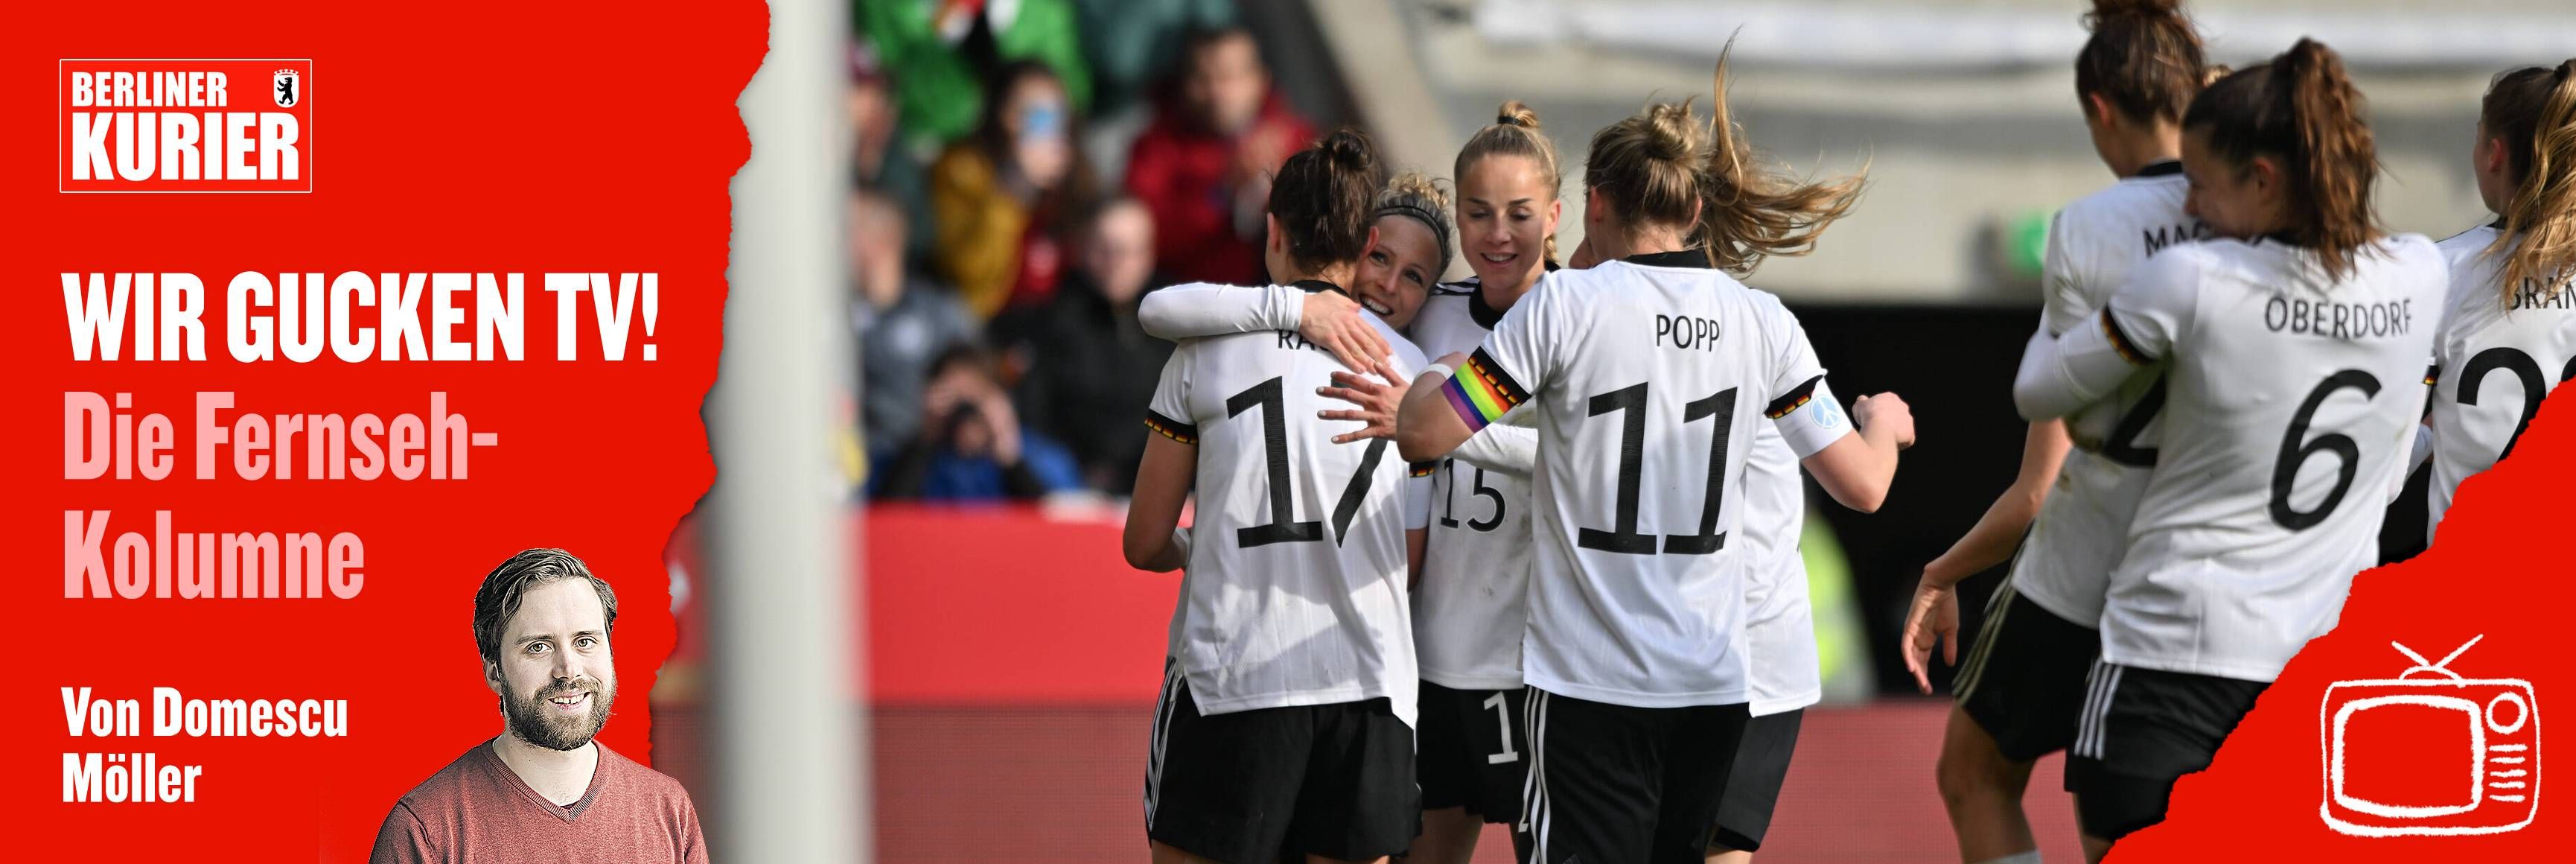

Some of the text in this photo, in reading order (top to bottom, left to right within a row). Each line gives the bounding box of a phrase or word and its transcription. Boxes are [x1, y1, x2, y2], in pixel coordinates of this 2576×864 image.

[1657, 314, 1720, 352] POPP
[2266, 296, 2411, 340] OBERDORF
[1578, 381, 1737, 555] 11
[2268, 369, 2382, 533] 6
[1440, 458, 1506, 533] 15
